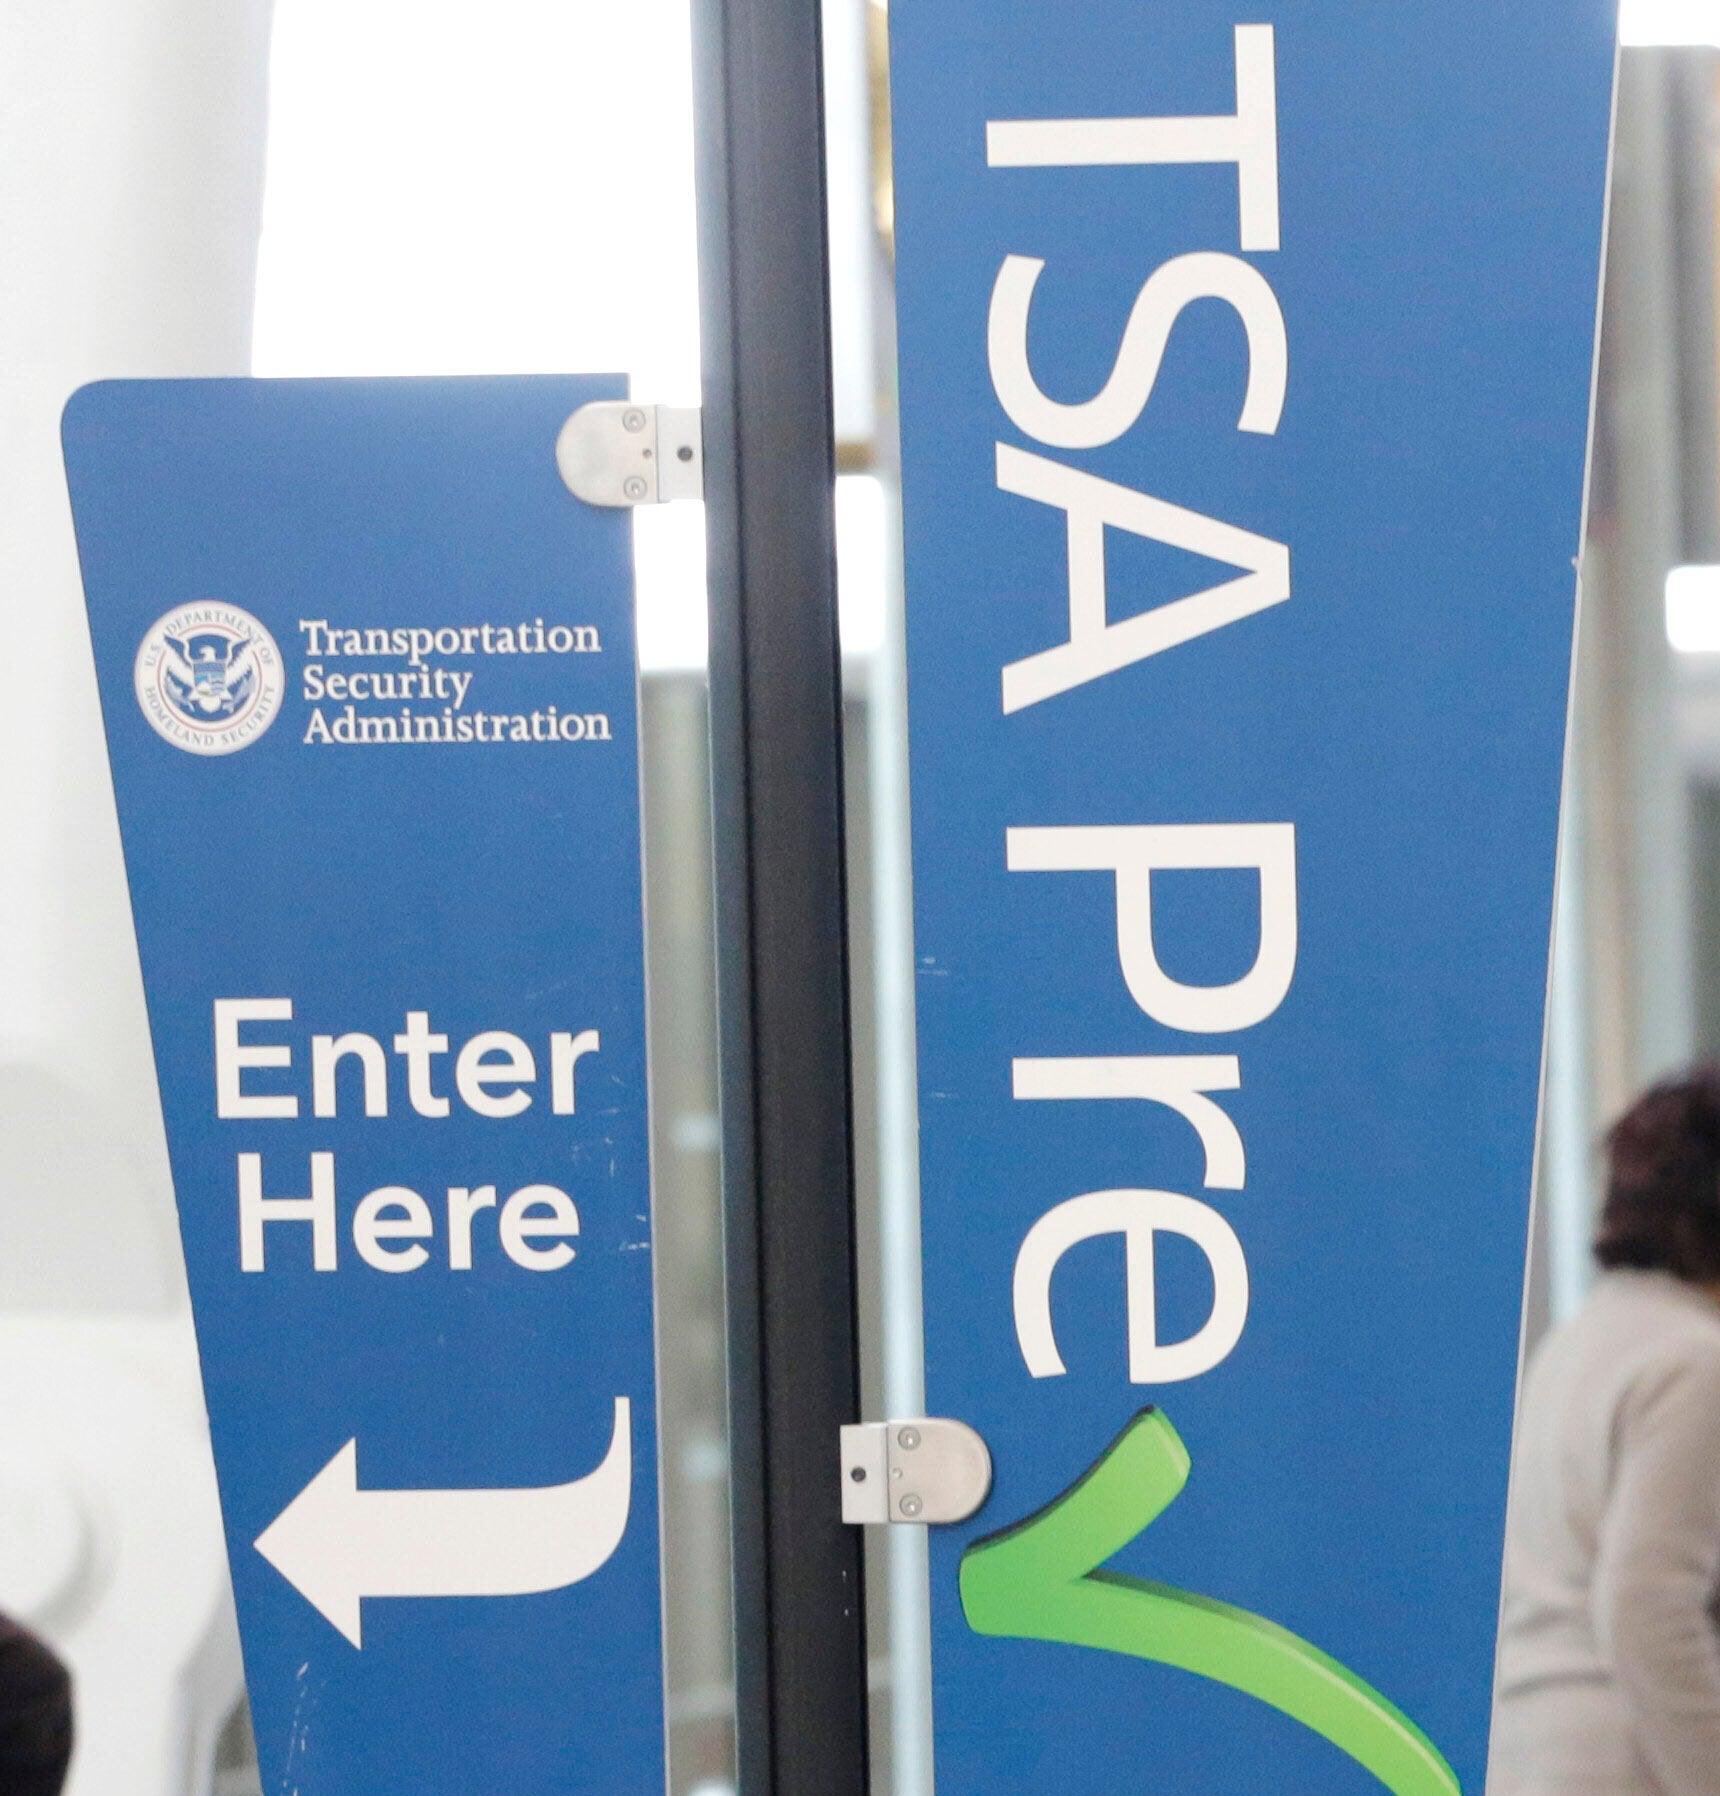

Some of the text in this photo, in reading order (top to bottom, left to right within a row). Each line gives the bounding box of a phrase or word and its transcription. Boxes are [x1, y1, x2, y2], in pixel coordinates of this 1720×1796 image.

[165, 609, 264, 647] DEPARTMENT
[299, 618, 602, 667] Transportation
[302, 664, 473, 709] Security
[985, 23, 1299, 1385] TSA Pre
[302, 702, 612, 744] Administration
[213, 997, 600, 1119] Enter
[237, 1151, 580, 1273] Here
